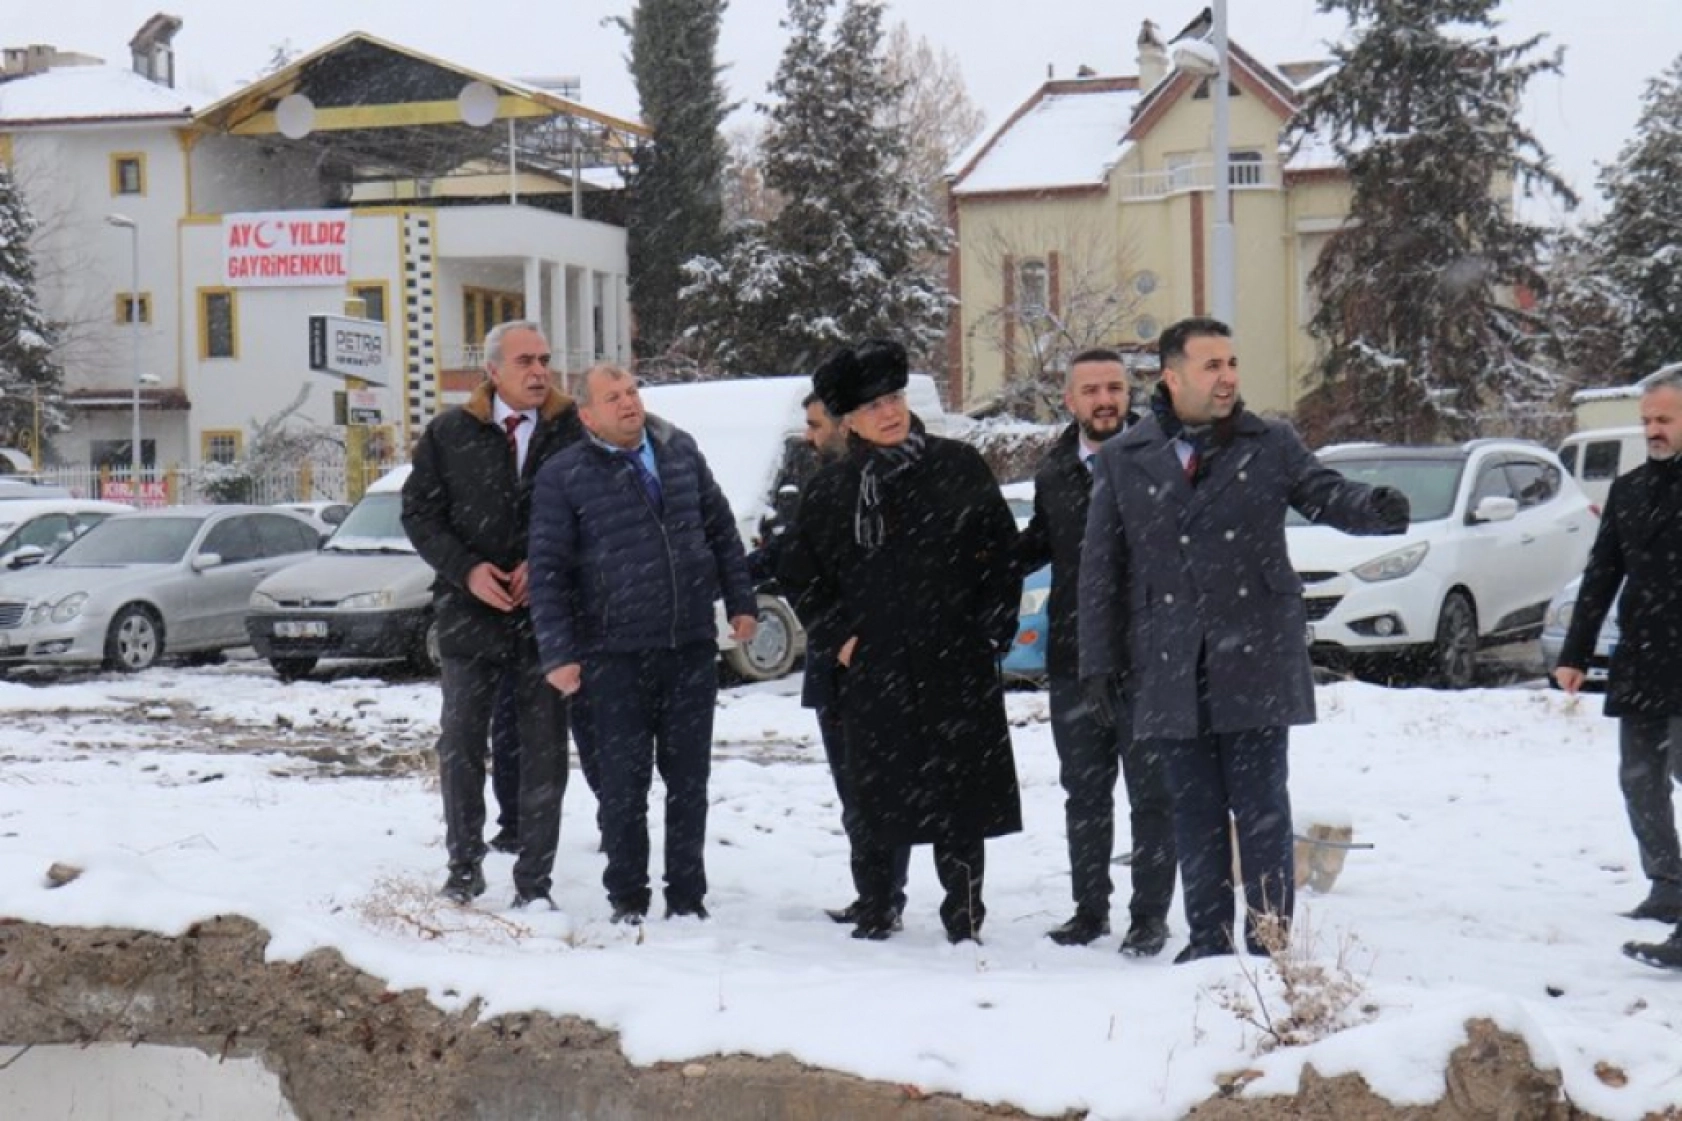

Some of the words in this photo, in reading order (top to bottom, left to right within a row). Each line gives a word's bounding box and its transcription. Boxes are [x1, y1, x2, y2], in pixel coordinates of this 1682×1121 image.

[229, 223, 253, 247] AY
[288, 221, 346, 246] YILDIZ
[229, 254, 346, 279] GAYRİMENKUL
[336, 329, 382, 355] PETRA
[104, 482, 165, 497] KIRLIK
